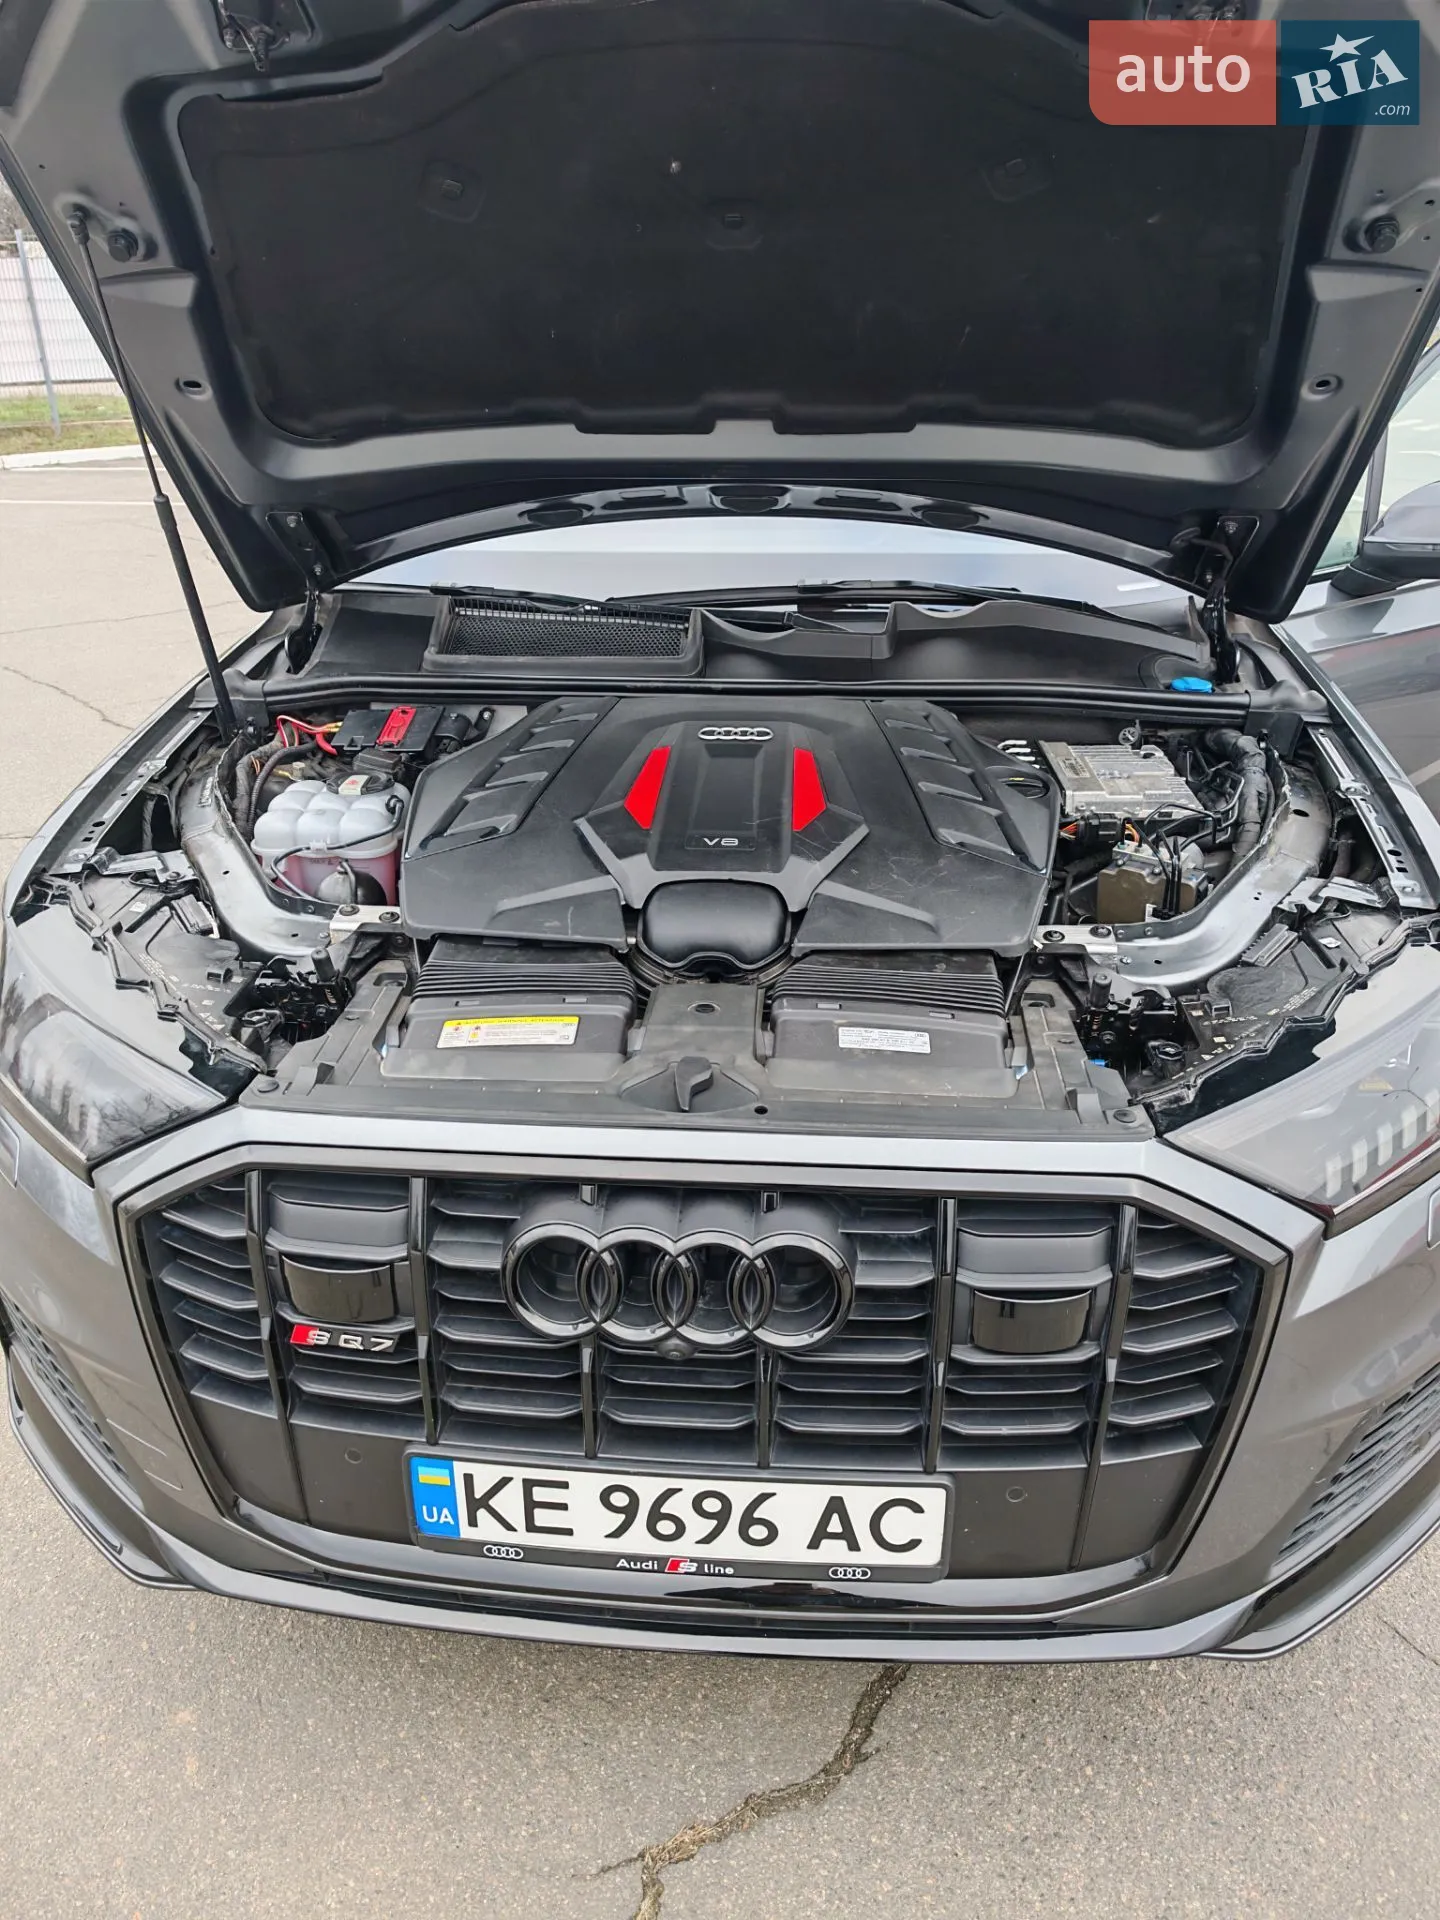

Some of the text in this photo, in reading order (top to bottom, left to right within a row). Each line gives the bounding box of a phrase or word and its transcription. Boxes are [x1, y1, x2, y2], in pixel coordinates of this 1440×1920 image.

[703, 837, 739, 846] V8
[422, 1505, 454, 1525] UA
[463, 1473, 925, 1553] KE 9696 AC
[616, 1558, 658, 1570] Audi
[704, 1563, 735, 1574] line
